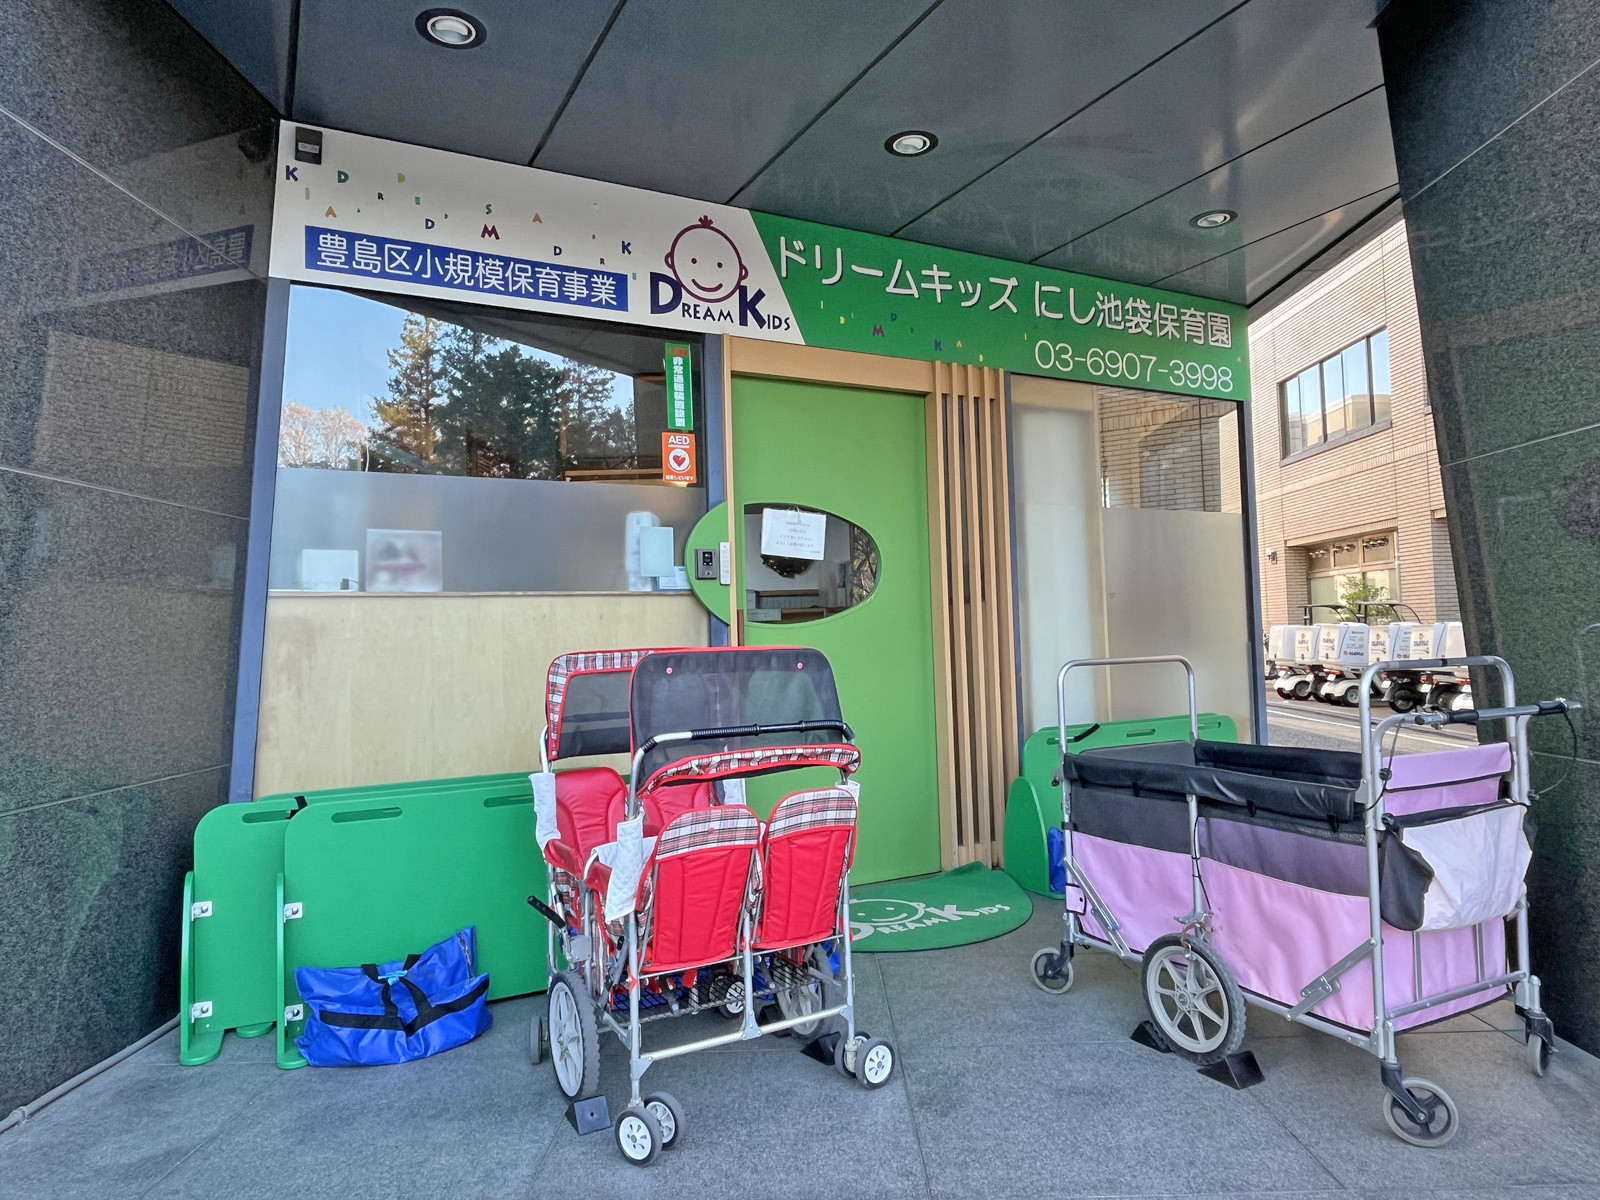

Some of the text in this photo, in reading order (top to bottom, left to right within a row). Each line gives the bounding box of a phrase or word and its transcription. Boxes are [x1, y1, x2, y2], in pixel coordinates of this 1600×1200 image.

[285, 165, 299, 182] K
[337, 170, 350, 184] D
[397, 172, 406, 184] D
[324, 205, 337, 218] A
[485, 203, 493, 215] S
[424, 217, 436, 230] D
[532, 212, 543, 224] A
[480, 223, 501, 240] M
[553, 245, 563, 257] D
[621, 241, 632, 256] K
[317, 233, 617, 306] 豊島区小規模保育事業
[780, 236, 1232, 349] ドリームキッズ にし池袋保育園
[649, 271, 791, 331] DREAM KIDS
[1034, 339, 1234, 393] 03-6907-3998
[668, 435, 690, 445] AED
